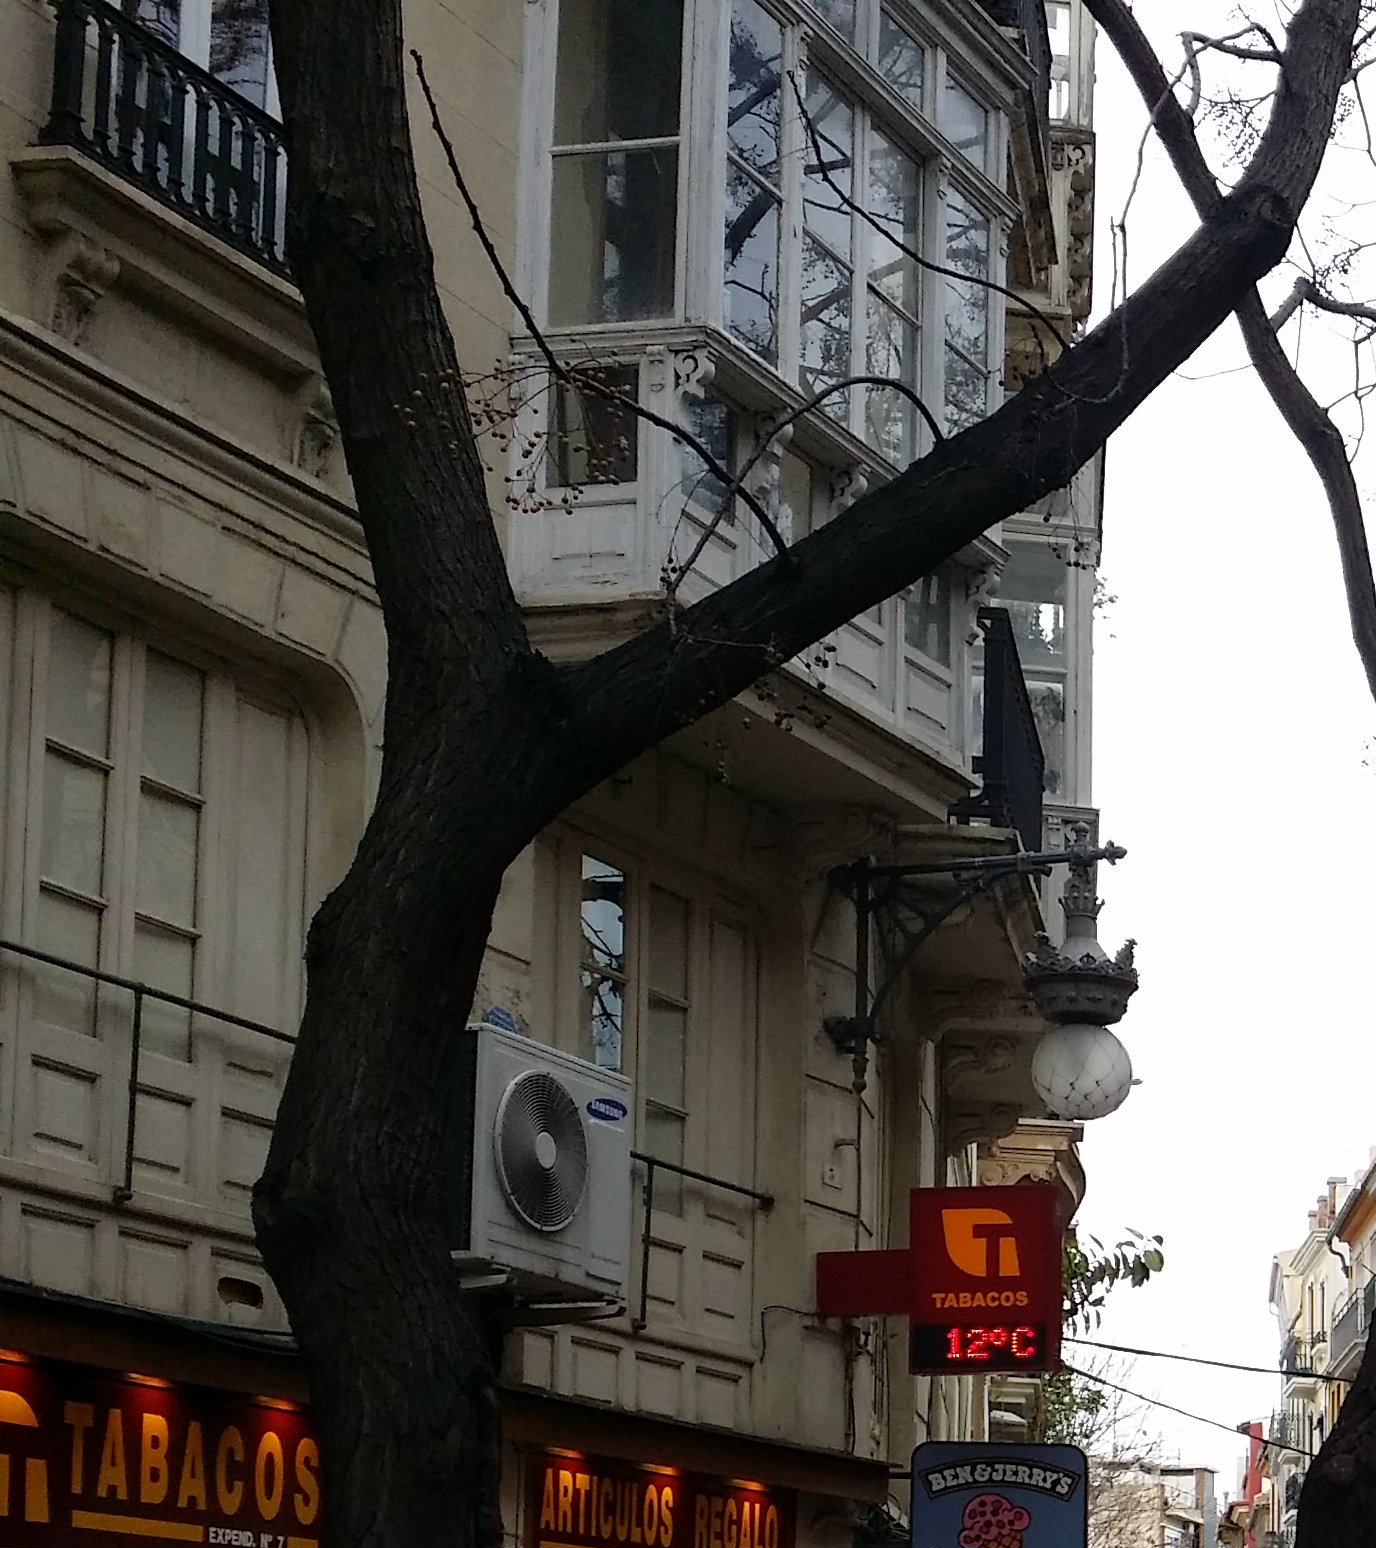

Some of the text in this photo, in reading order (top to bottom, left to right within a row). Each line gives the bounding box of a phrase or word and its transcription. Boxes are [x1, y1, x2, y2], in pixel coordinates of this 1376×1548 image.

[931, 1291, 1029, 1308] TABACOS
[63, 1400, 320, 1526] TABACOS
[540, 1468, 674, 1548] ARTICULOS
[208, 1526, 256, 1548] EXPEND.
